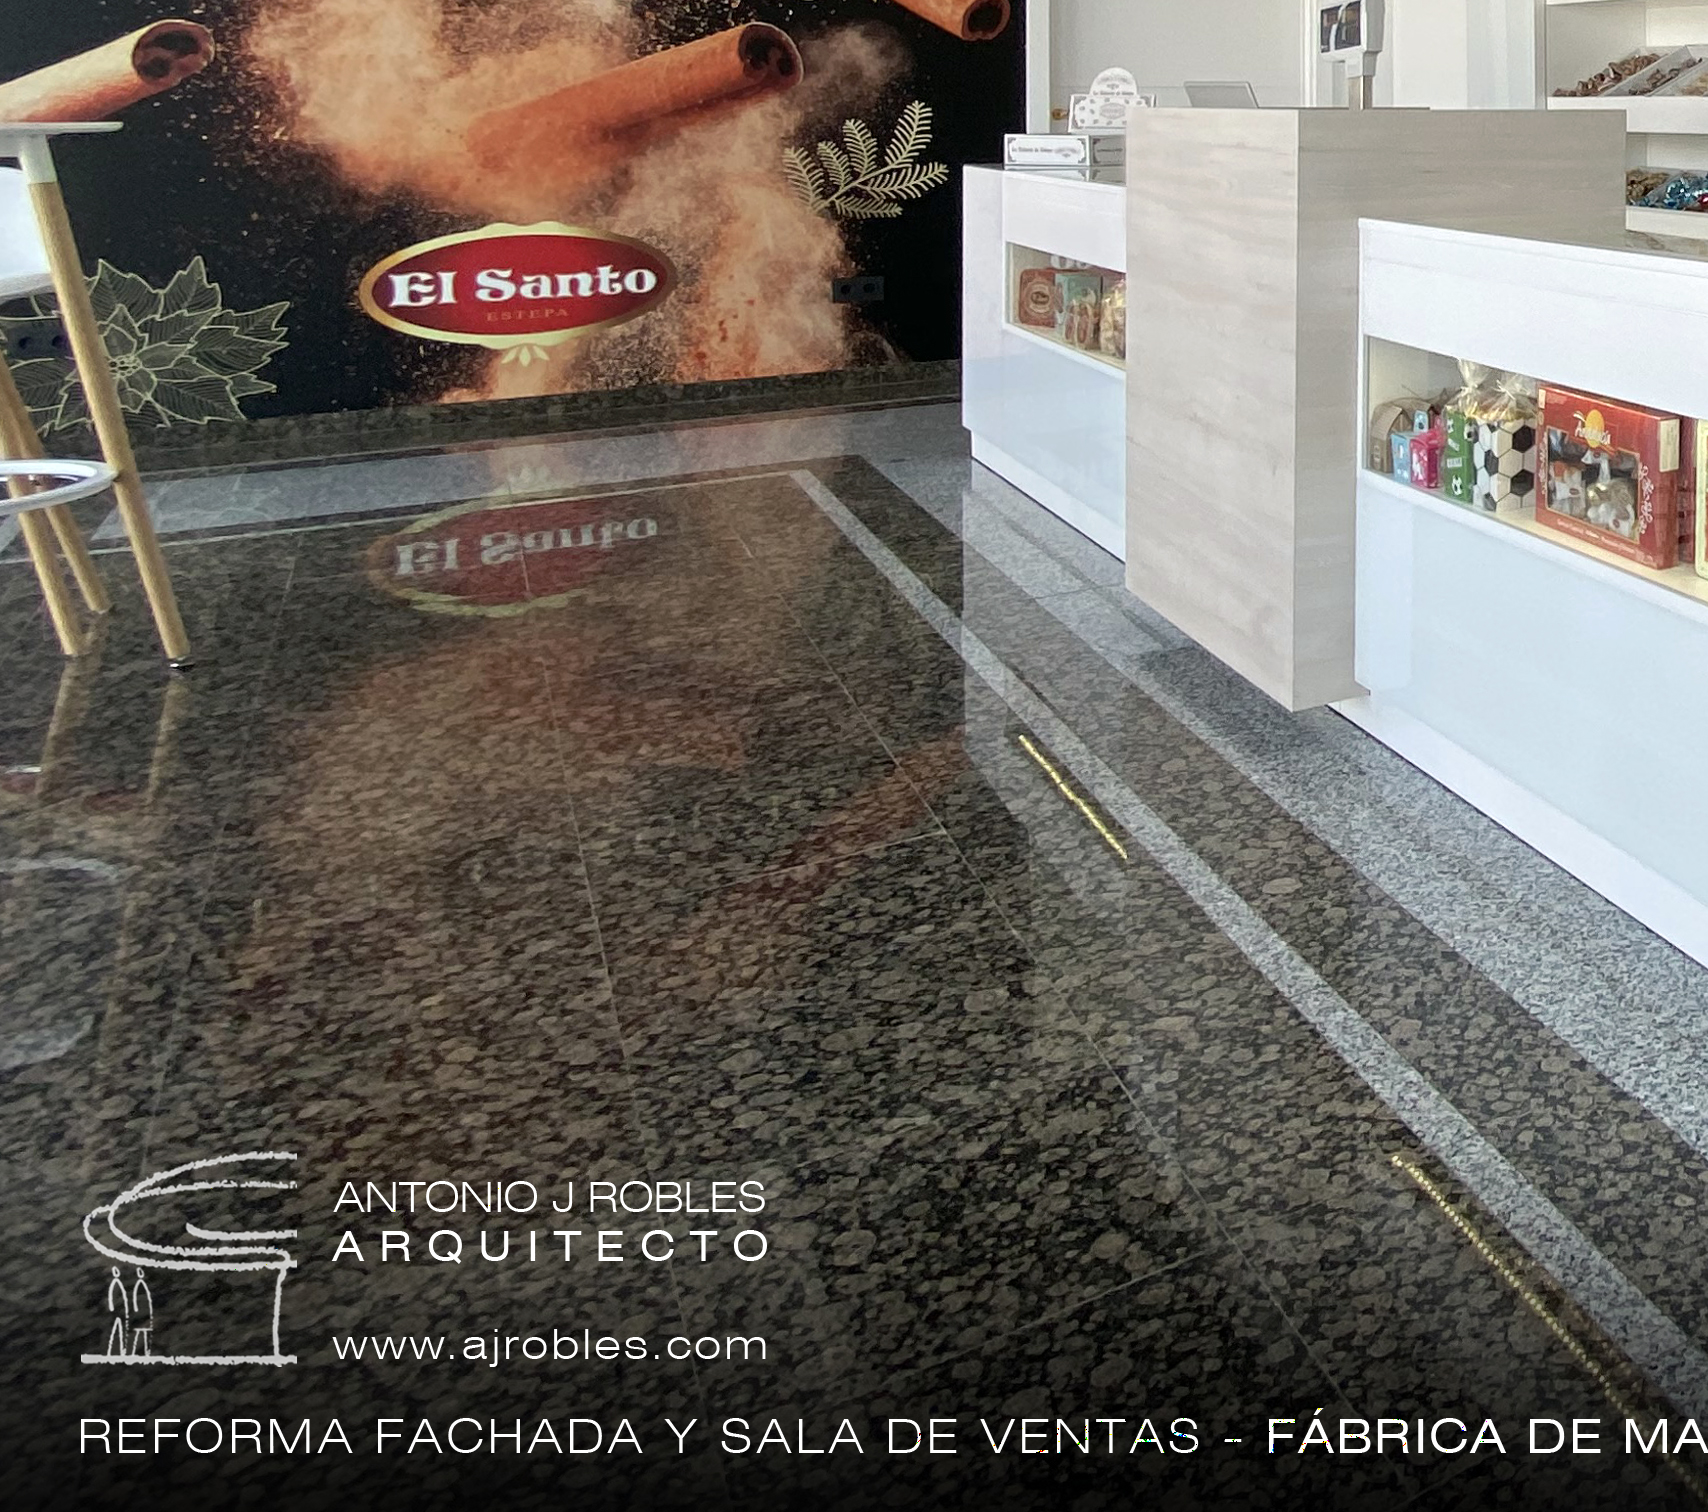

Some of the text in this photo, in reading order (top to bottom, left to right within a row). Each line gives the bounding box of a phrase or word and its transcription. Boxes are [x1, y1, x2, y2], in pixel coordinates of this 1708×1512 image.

[388, 264, 658, 308] El Santo
[486, 308, 569, 323] ESTEPA
